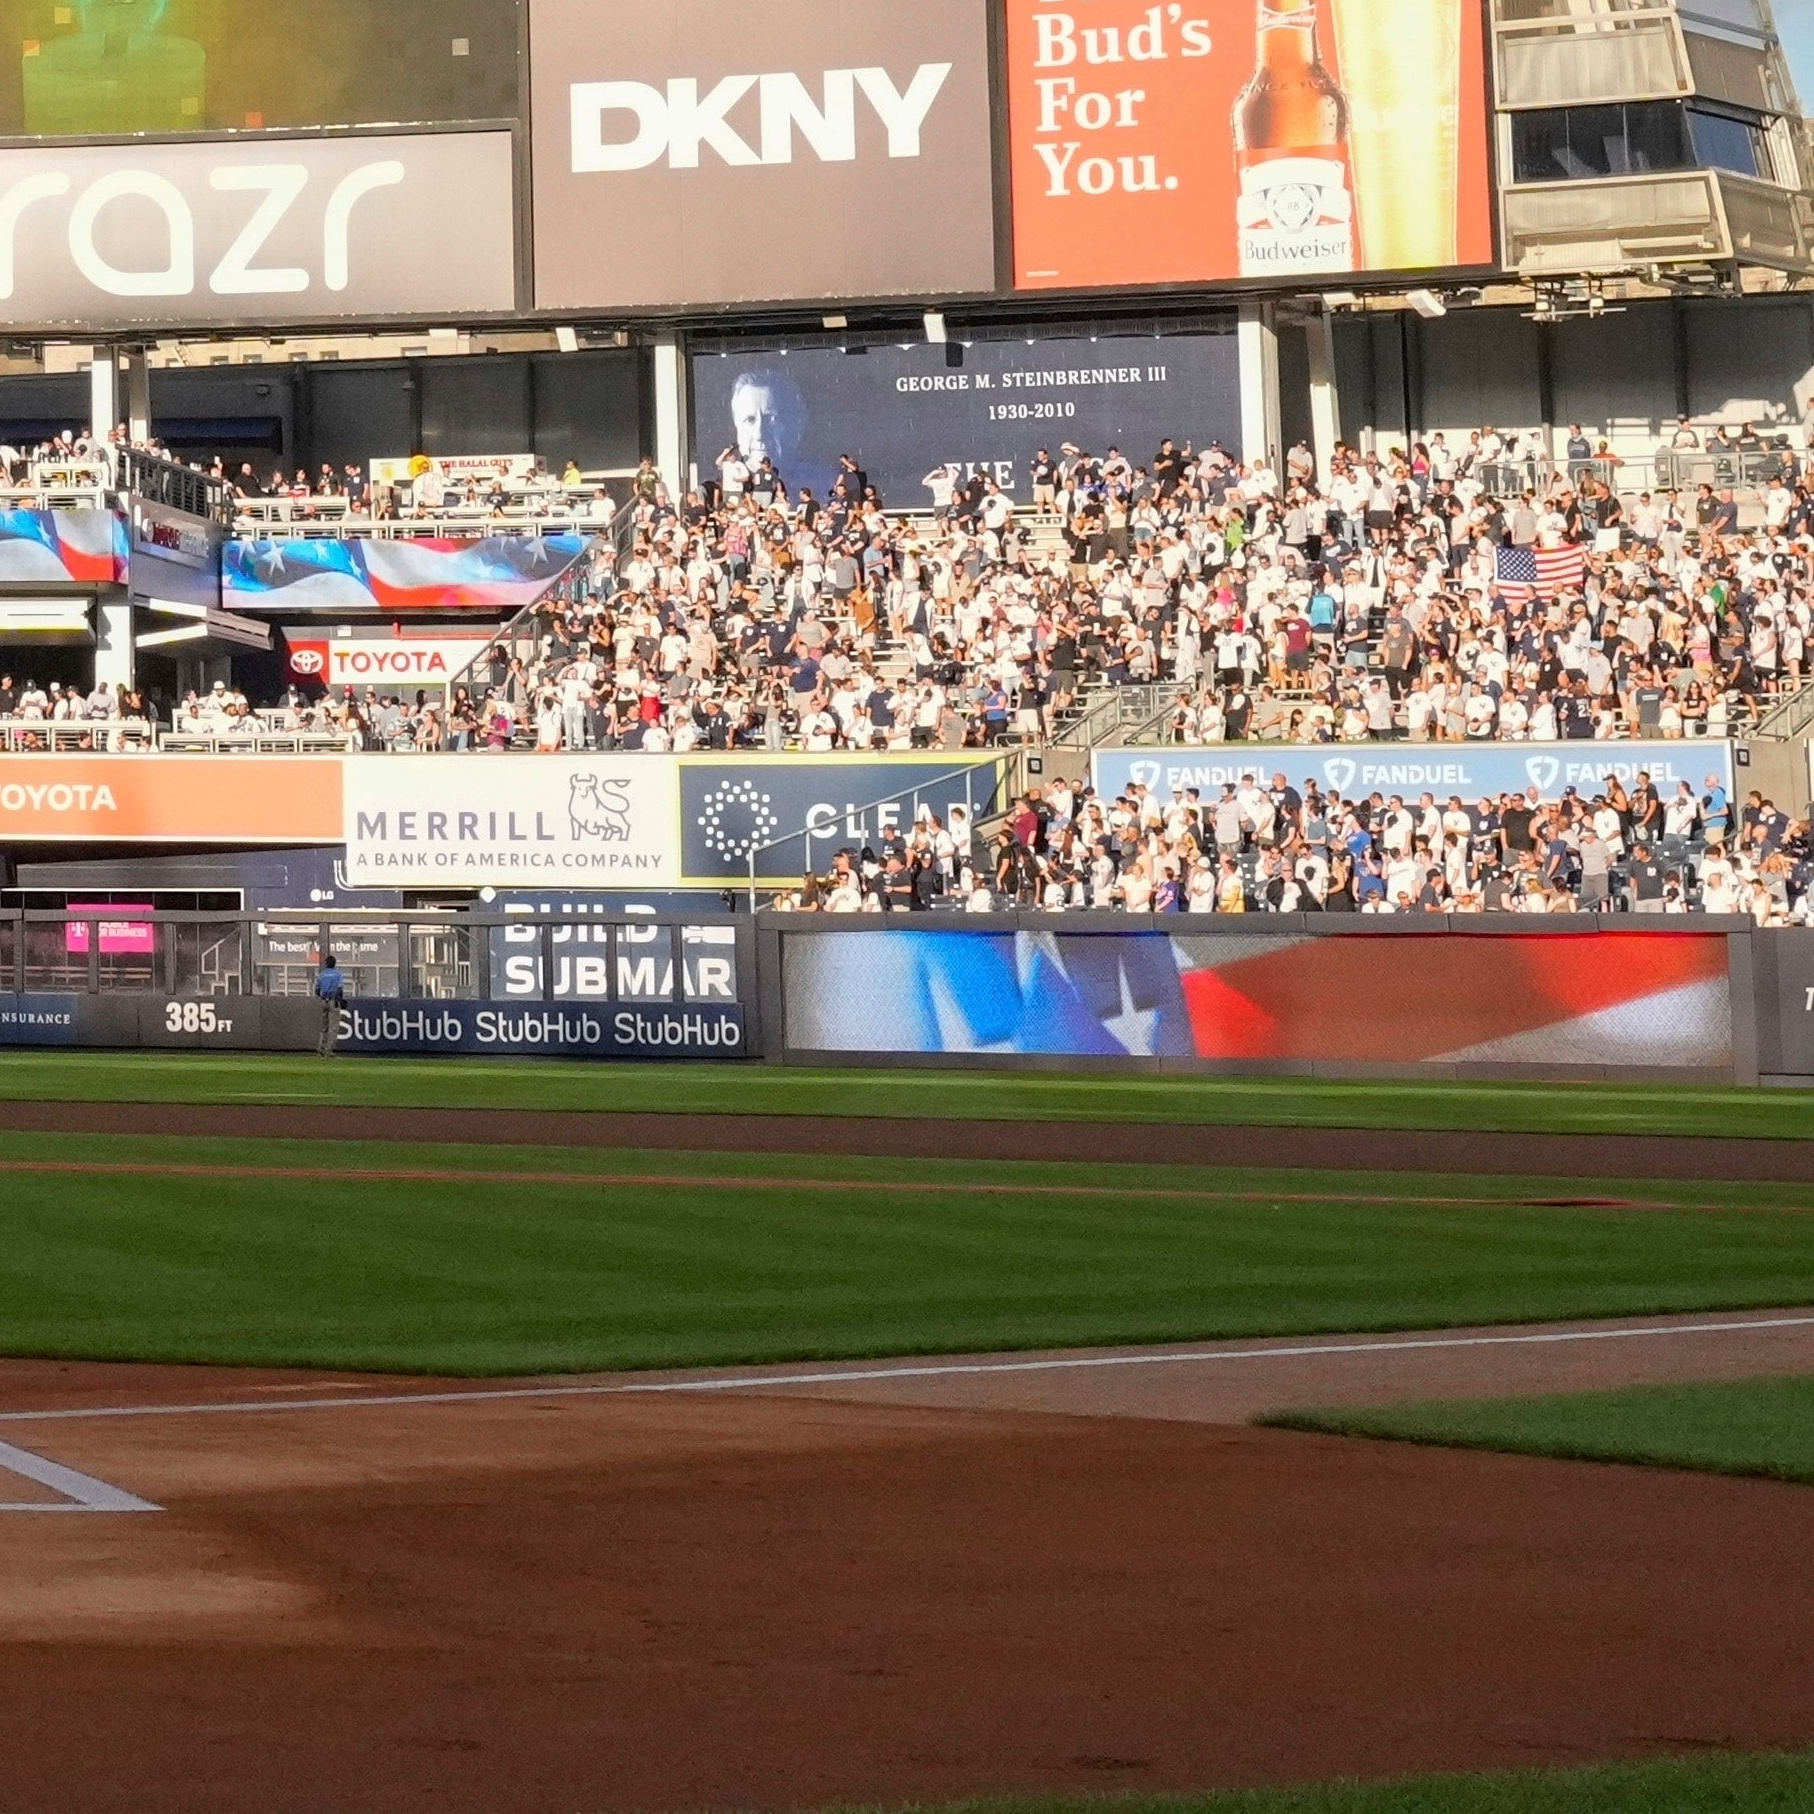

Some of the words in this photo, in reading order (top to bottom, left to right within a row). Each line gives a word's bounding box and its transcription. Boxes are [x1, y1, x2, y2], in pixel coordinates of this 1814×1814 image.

[1033, 3, 1213, 68] Bud's
[569, 61, 952, 174] DKNY
[1035, 77, 1146, 133] For
[1034, 140, 1182, 198] You.
[1245, 238, 1347, 260] Budweiser
[895, 374, 970, 393] GEORGE
[974, 373, 997, 390] M.
[1002, 368, 1144, 390] STEINBRENNER
[1147, 365, 1167, 383] III
[987, 401, 1076, 422] 1930-2010
[334, 649, 448, 674] TOYOTA
[1165, 762, 1273, 787] FANDUEL
[1362, 763, 1473, 786] FANDUEL
[1565, 760, 1680, 784] FANDUEL
[357, 811, 556, 842] MERRILL
[356, 852, 368, 867] A
[374, 853, 428, 867] BANK
[435, 853, 460, 867] OF
[464, 853, 559, 867] AMERICA
[562, 853, 663, 869] COMPANY
[322, 890, 334, 900] LG
[504, 903, 658, 943] BUILD
[269, 941, 286, 952] The
[335, 941, 351, 952] the
[505, 955, 733, 996] SUBMAR
[336, 1010, 462, 1042] StubHub
[475, 1011, 601, 1044] StubHub
[614, 1012, 740, 1046] StubHub
